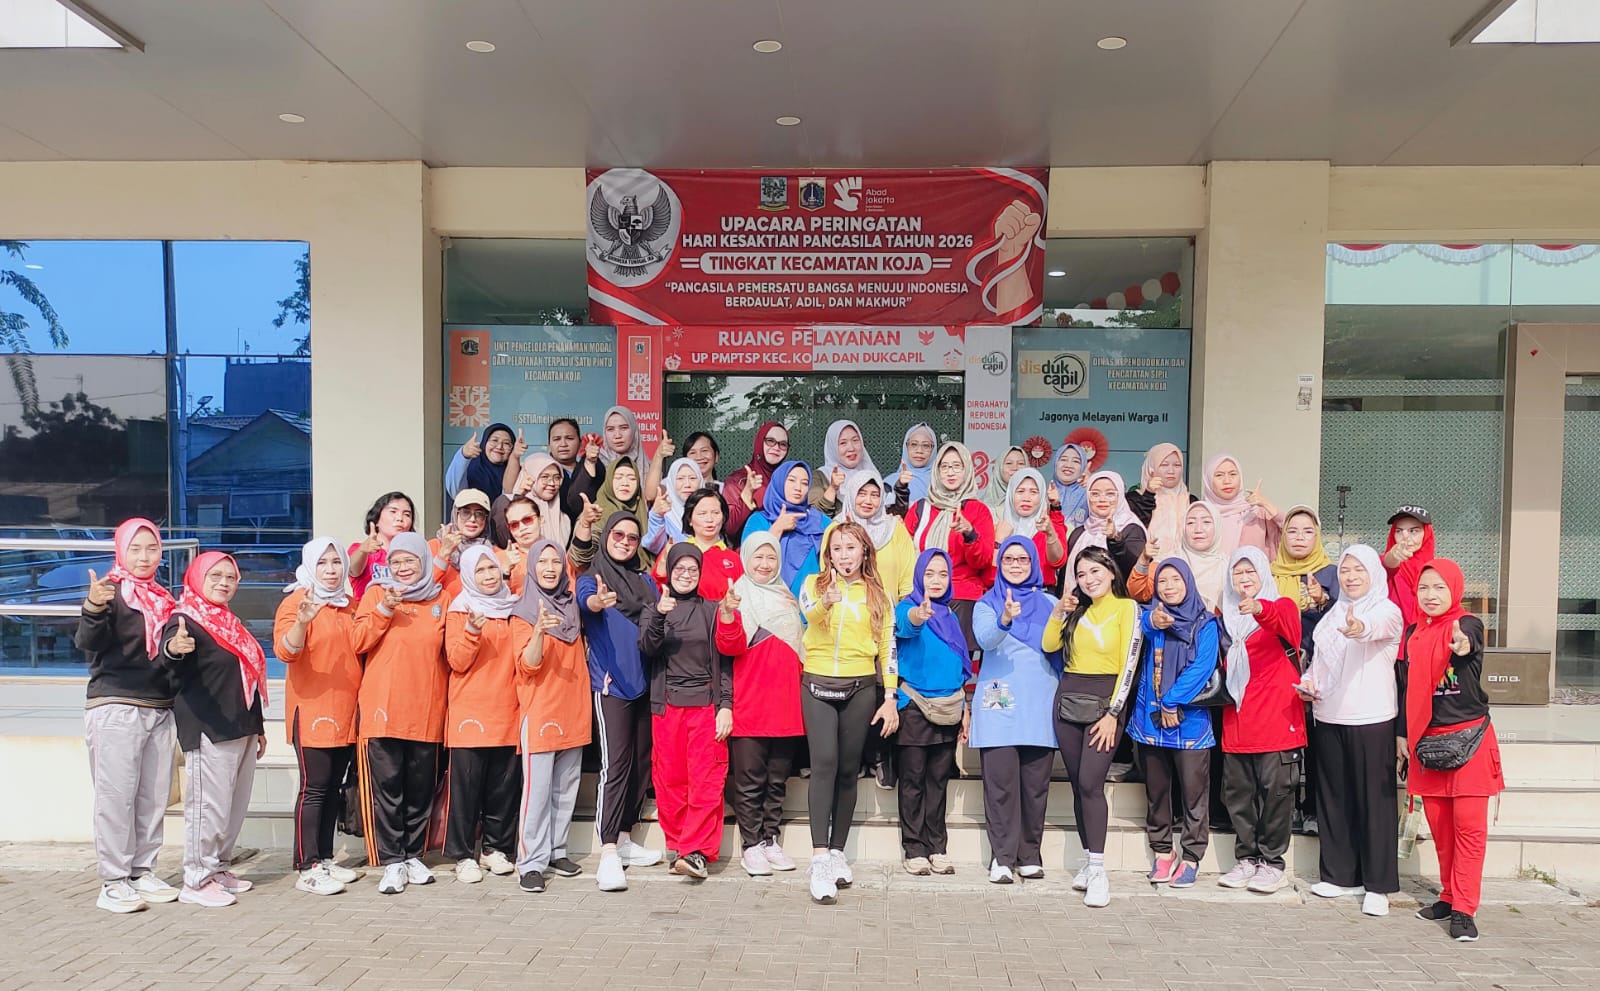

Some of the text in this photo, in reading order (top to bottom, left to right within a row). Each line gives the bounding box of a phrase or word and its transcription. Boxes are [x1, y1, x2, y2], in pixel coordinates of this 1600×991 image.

[866, 188, 887, 196] Abad
[720, 216, 922, 232] UPACARA PERINGATAN
[682, 234, 973, 248] HARI KESAKTIAN PANCASILA TAHUN 2026
[709, 256, 924, 271] TINGKAT KECAMATAN KOJA
[737, 282, 804, 293] PEMERSATU
[807, 282, 854, 294] BANGSA
[858, 282, 904, 294] MENUJU
[907, 282, 969, 294] INDONESIA
[725, 296, 793, 309] BERDAULAT,
[796, 296, 825, 309] ADIL,
[828, 296, 852, 308] DAN
[718, 330, 901, 347] RUANG PELAYANAN
[494, 341, 509, 352] UNIT
[511, 341, 547, 352] PENGELOLA
[589, 341, 612, 353] MODAL
[492, 355, 613, 368] DAN PELAYANAN TERPADU SATU PINTU
[691, 352, 708, 364] UP
[711, 352, 761, 364] PMPTSP
[832, 352, 860, 364] DAN
[862, 351, 925, 364] DUKCAPIL
[1092, 357, 1114, 367] DINAS
[1170, 358, 1185, 368] DAN
[982, 361, 1004, 372] capil
[524, 370, 581, 381] KECAMATAN KOJA
[1043, 370, 1078, 389] capil
[1107, 369, 1168, 379] PENCATATAN SIPIL
[1108, 381, 1167, 391] KECAMATAN KOJA
[967, 400, 1009, 408] DIRGAHAYU
[632, 411, 659, 420] AHAYU
[969, 411, 1006, 419] REPUBLIK
[1039, 411, 1080, 423] Jagonya
[1082, 411, 1126, 423] Melayani
[1128, 412, 1160, 424] Warga
[968, 422, 1007, 430] INDONESIA
